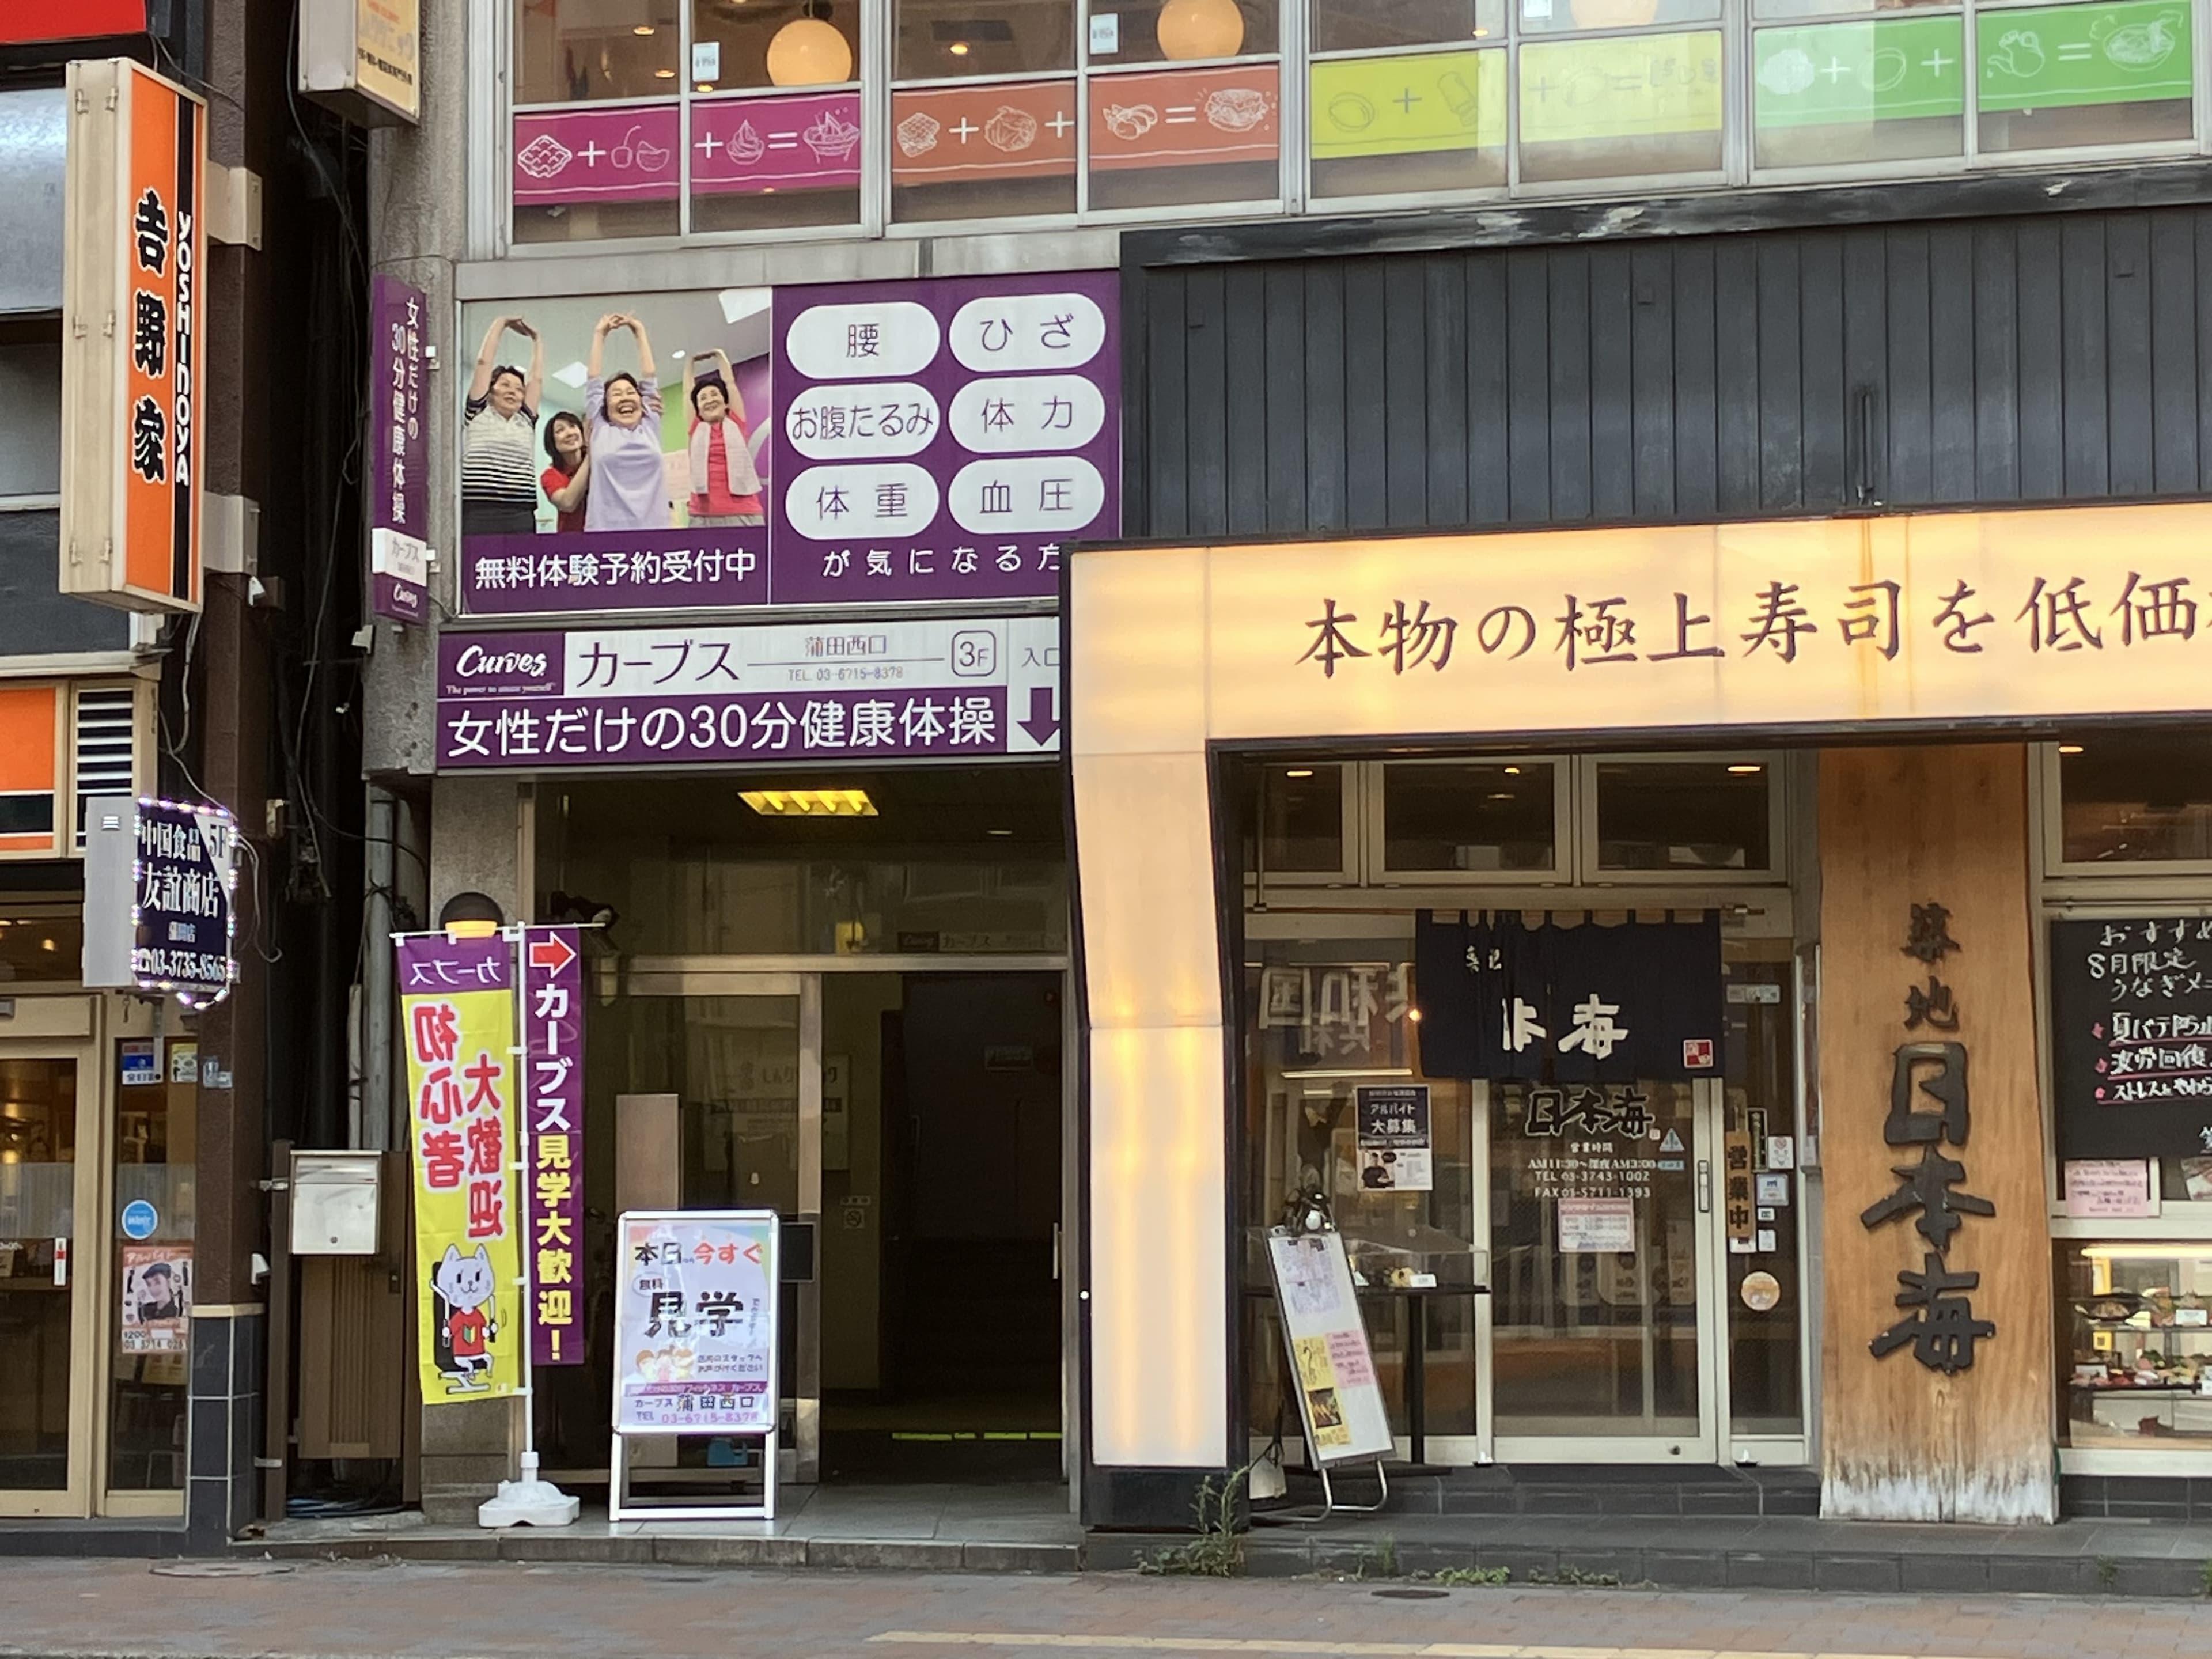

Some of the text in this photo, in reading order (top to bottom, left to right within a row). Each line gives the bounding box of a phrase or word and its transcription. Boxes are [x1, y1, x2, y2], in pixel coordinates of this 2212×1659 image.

[176, 211, 191, 486] YOSHINOYA
[846, 323, 880, 358] 腰
[980, 314, 1074, 351] ひざ
[406, 297, 419, 440] 女性だけの
[792, 404, 934, 440] お腹たるみ
[981, 396, 1072, 433] 体力
[816, 483, 908, 520] 体重
[980, 479, 1073, 514] 血圧
[475, 548, 755, 590] 無料体験予約受付中
[1295, 571, 2212, 679] 本物の極上寿司を低価
[456, 645, 547, 677] Curves
[577, 639, 740, 688] カーブス
[805, 635, 886, 657] 蒲田西口
[960, 641, 988, 667] 3F
[448, 696, 996, 757] 女性だけの30分健康体操
[142, 819, 200, 861] 中国食品
[142, 862, 219, 918] 友誼商店
[1370, 1103, 1415, 1115] アルバイト
[1526, 1085, 1656, 1139] 日本海
[1535, 1171, 1557, 1181] TEL
[1535, 1187, 1559, 1198] FAX
[1728, 1145, 1749, 1229] 営業中
[634, 1242, 682, 1266] 本日
[693, 1240, 763, 1265] 今すぐ
[643, 1290, 744, 1338] 見学
